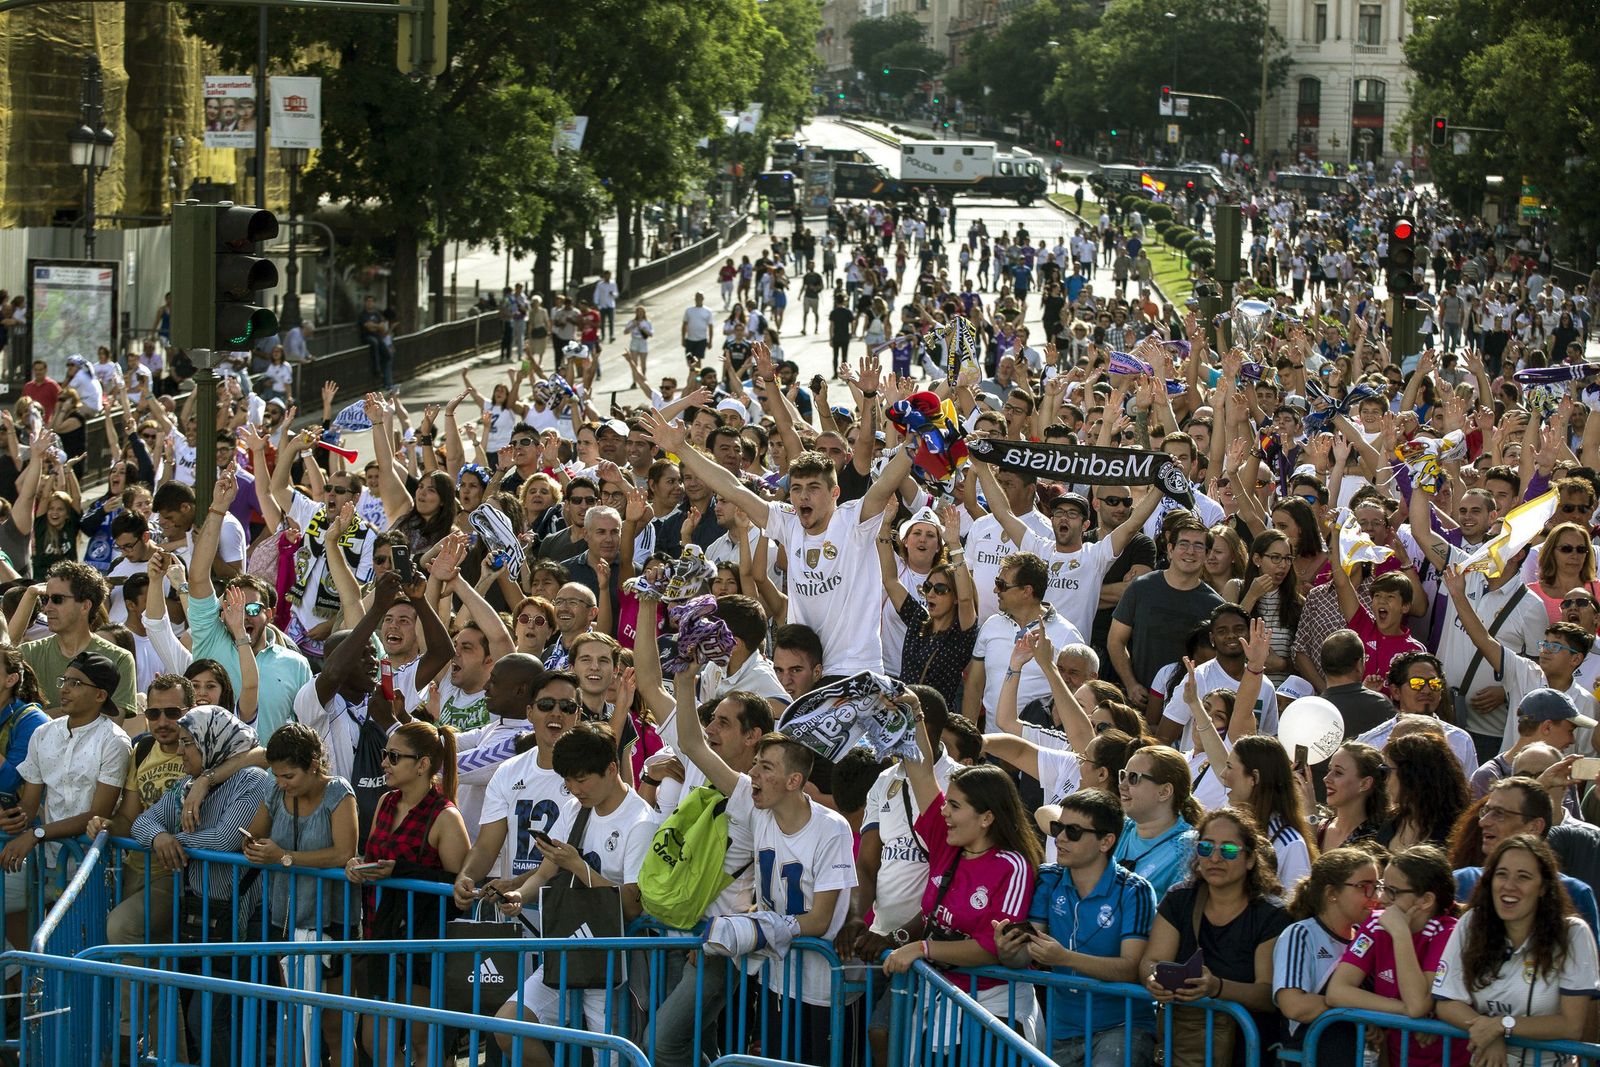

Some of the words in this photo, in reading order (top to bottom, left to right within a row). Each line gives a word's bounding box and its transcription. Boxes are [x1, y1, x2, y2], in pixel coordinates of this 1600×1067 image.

[996, 545, 1011, 555] Fly
[803, 571, 824, 582] Fly
[515, 799, 560, 861] 12
[937, 905, 953, 926] Fly
[467, 973, 504, 984] aidas
[1486, 1000, 1512, 1015] Fly
